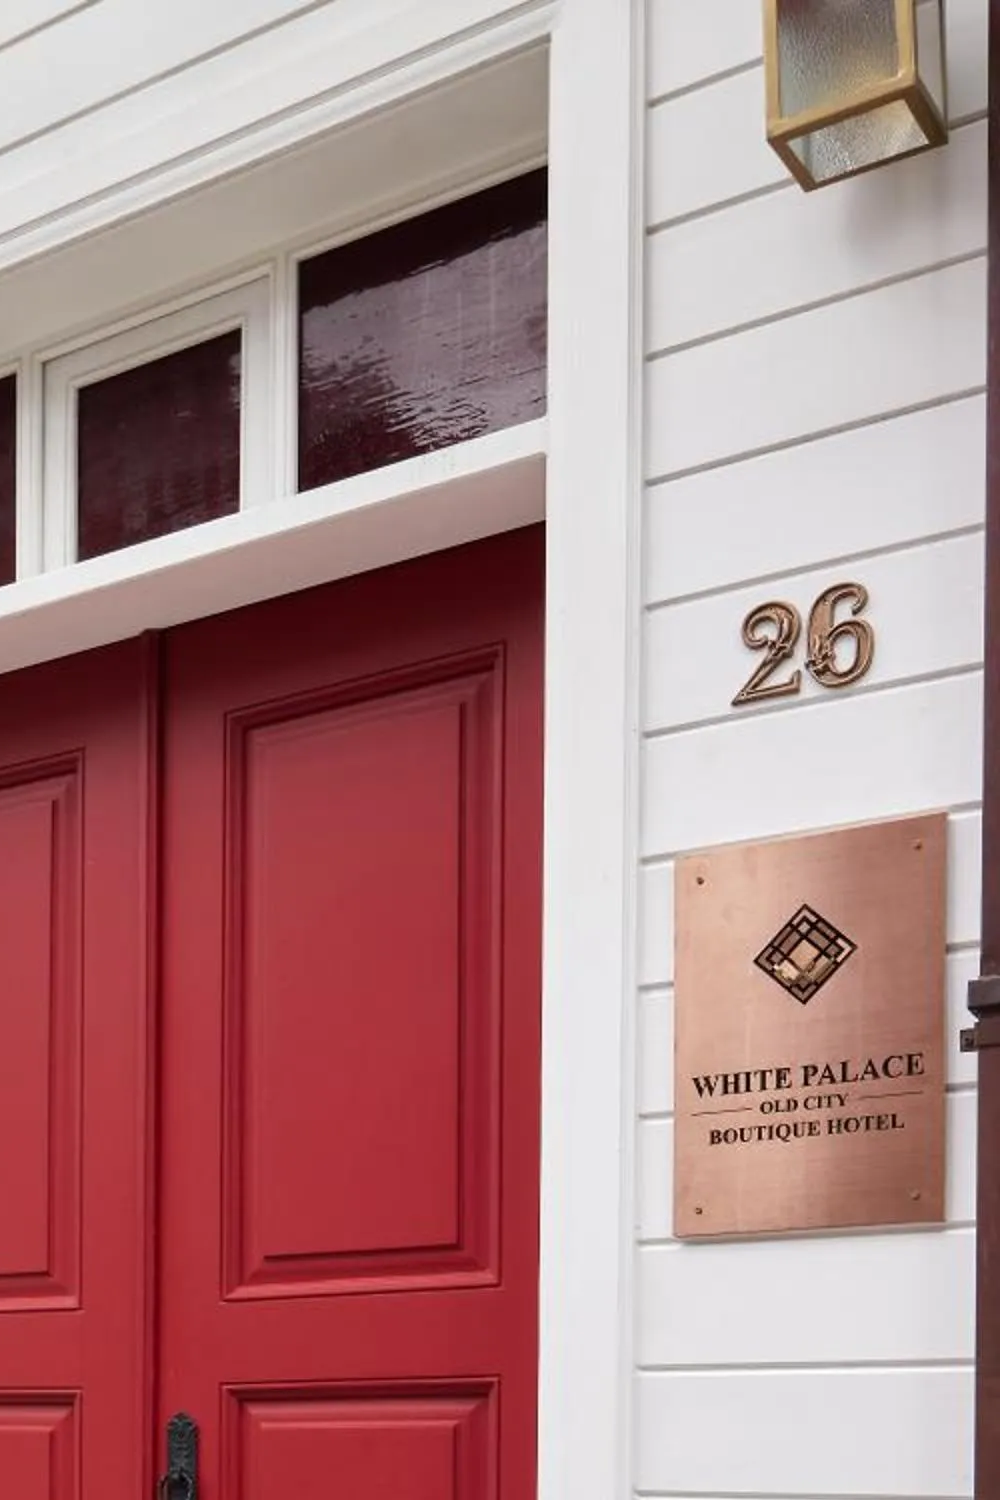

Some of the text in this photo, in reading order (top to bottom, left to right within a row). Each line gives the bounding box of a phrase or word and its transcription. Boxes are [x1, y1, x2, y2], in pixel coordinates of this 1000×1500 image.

[731, 582, 874, 706] 26
[692, 1053, 925, 1098] WHITE PALACE
[760, 1093, 849, 1115] OLD CITY
[710, 1113, 905, 1146] BOUTIQUE HOTEL
